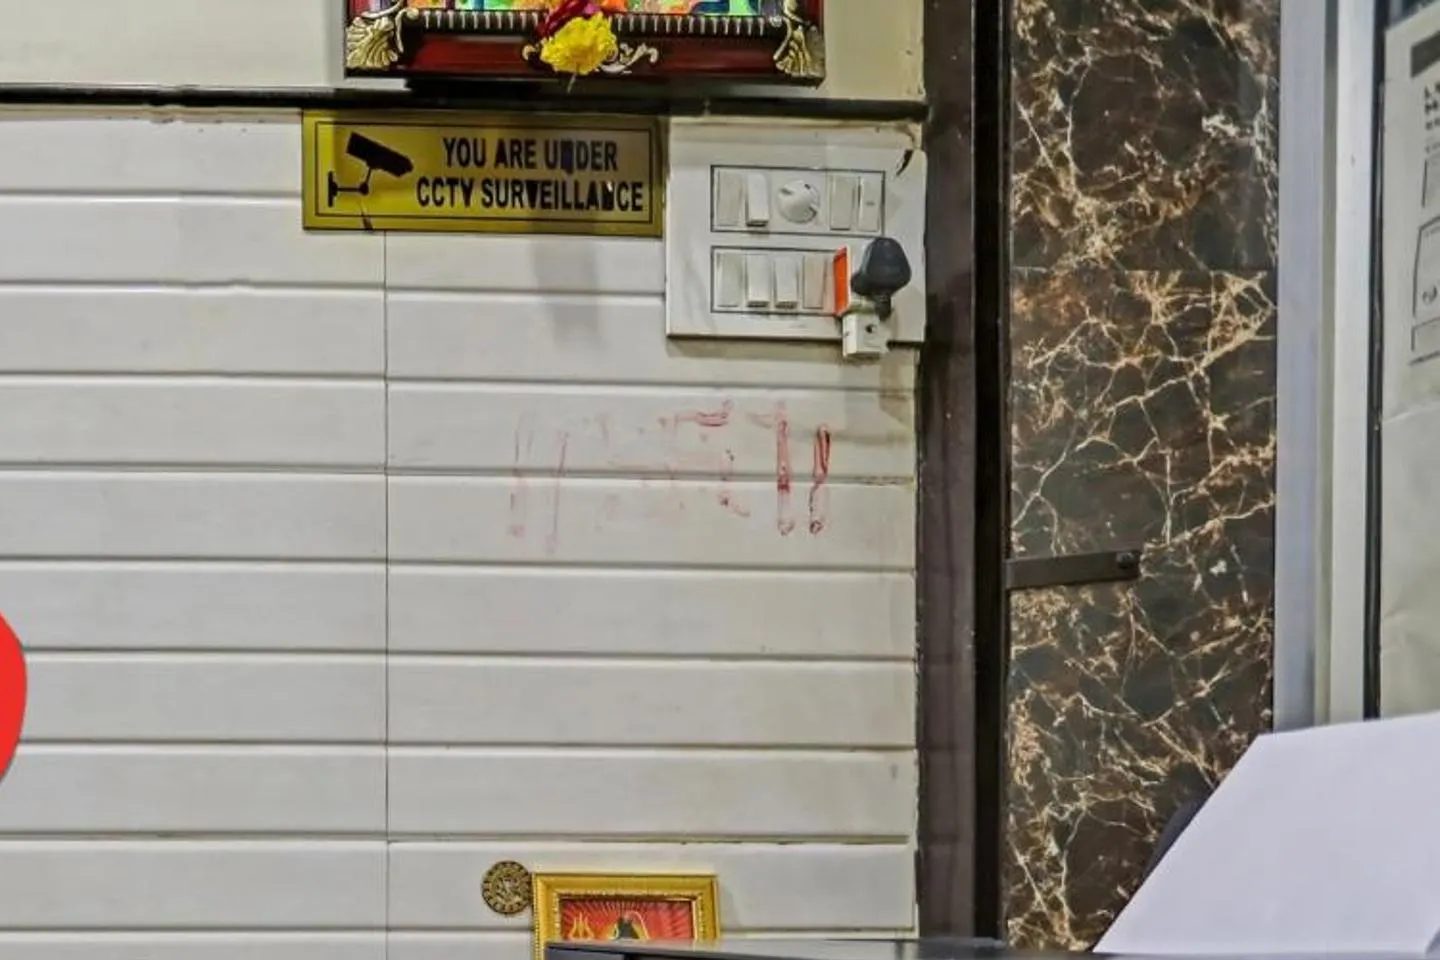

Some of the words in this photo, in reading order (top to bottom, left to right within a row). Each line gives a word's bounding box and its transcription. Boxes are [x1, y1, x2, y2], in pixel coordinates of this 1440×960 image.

[443, 137, 487, 168] YOU
[494, 139, 537, 169] ARE
[416, 177, 474, 209] CCTV
[481, 178, 644, 211] SURVEILLANCE
